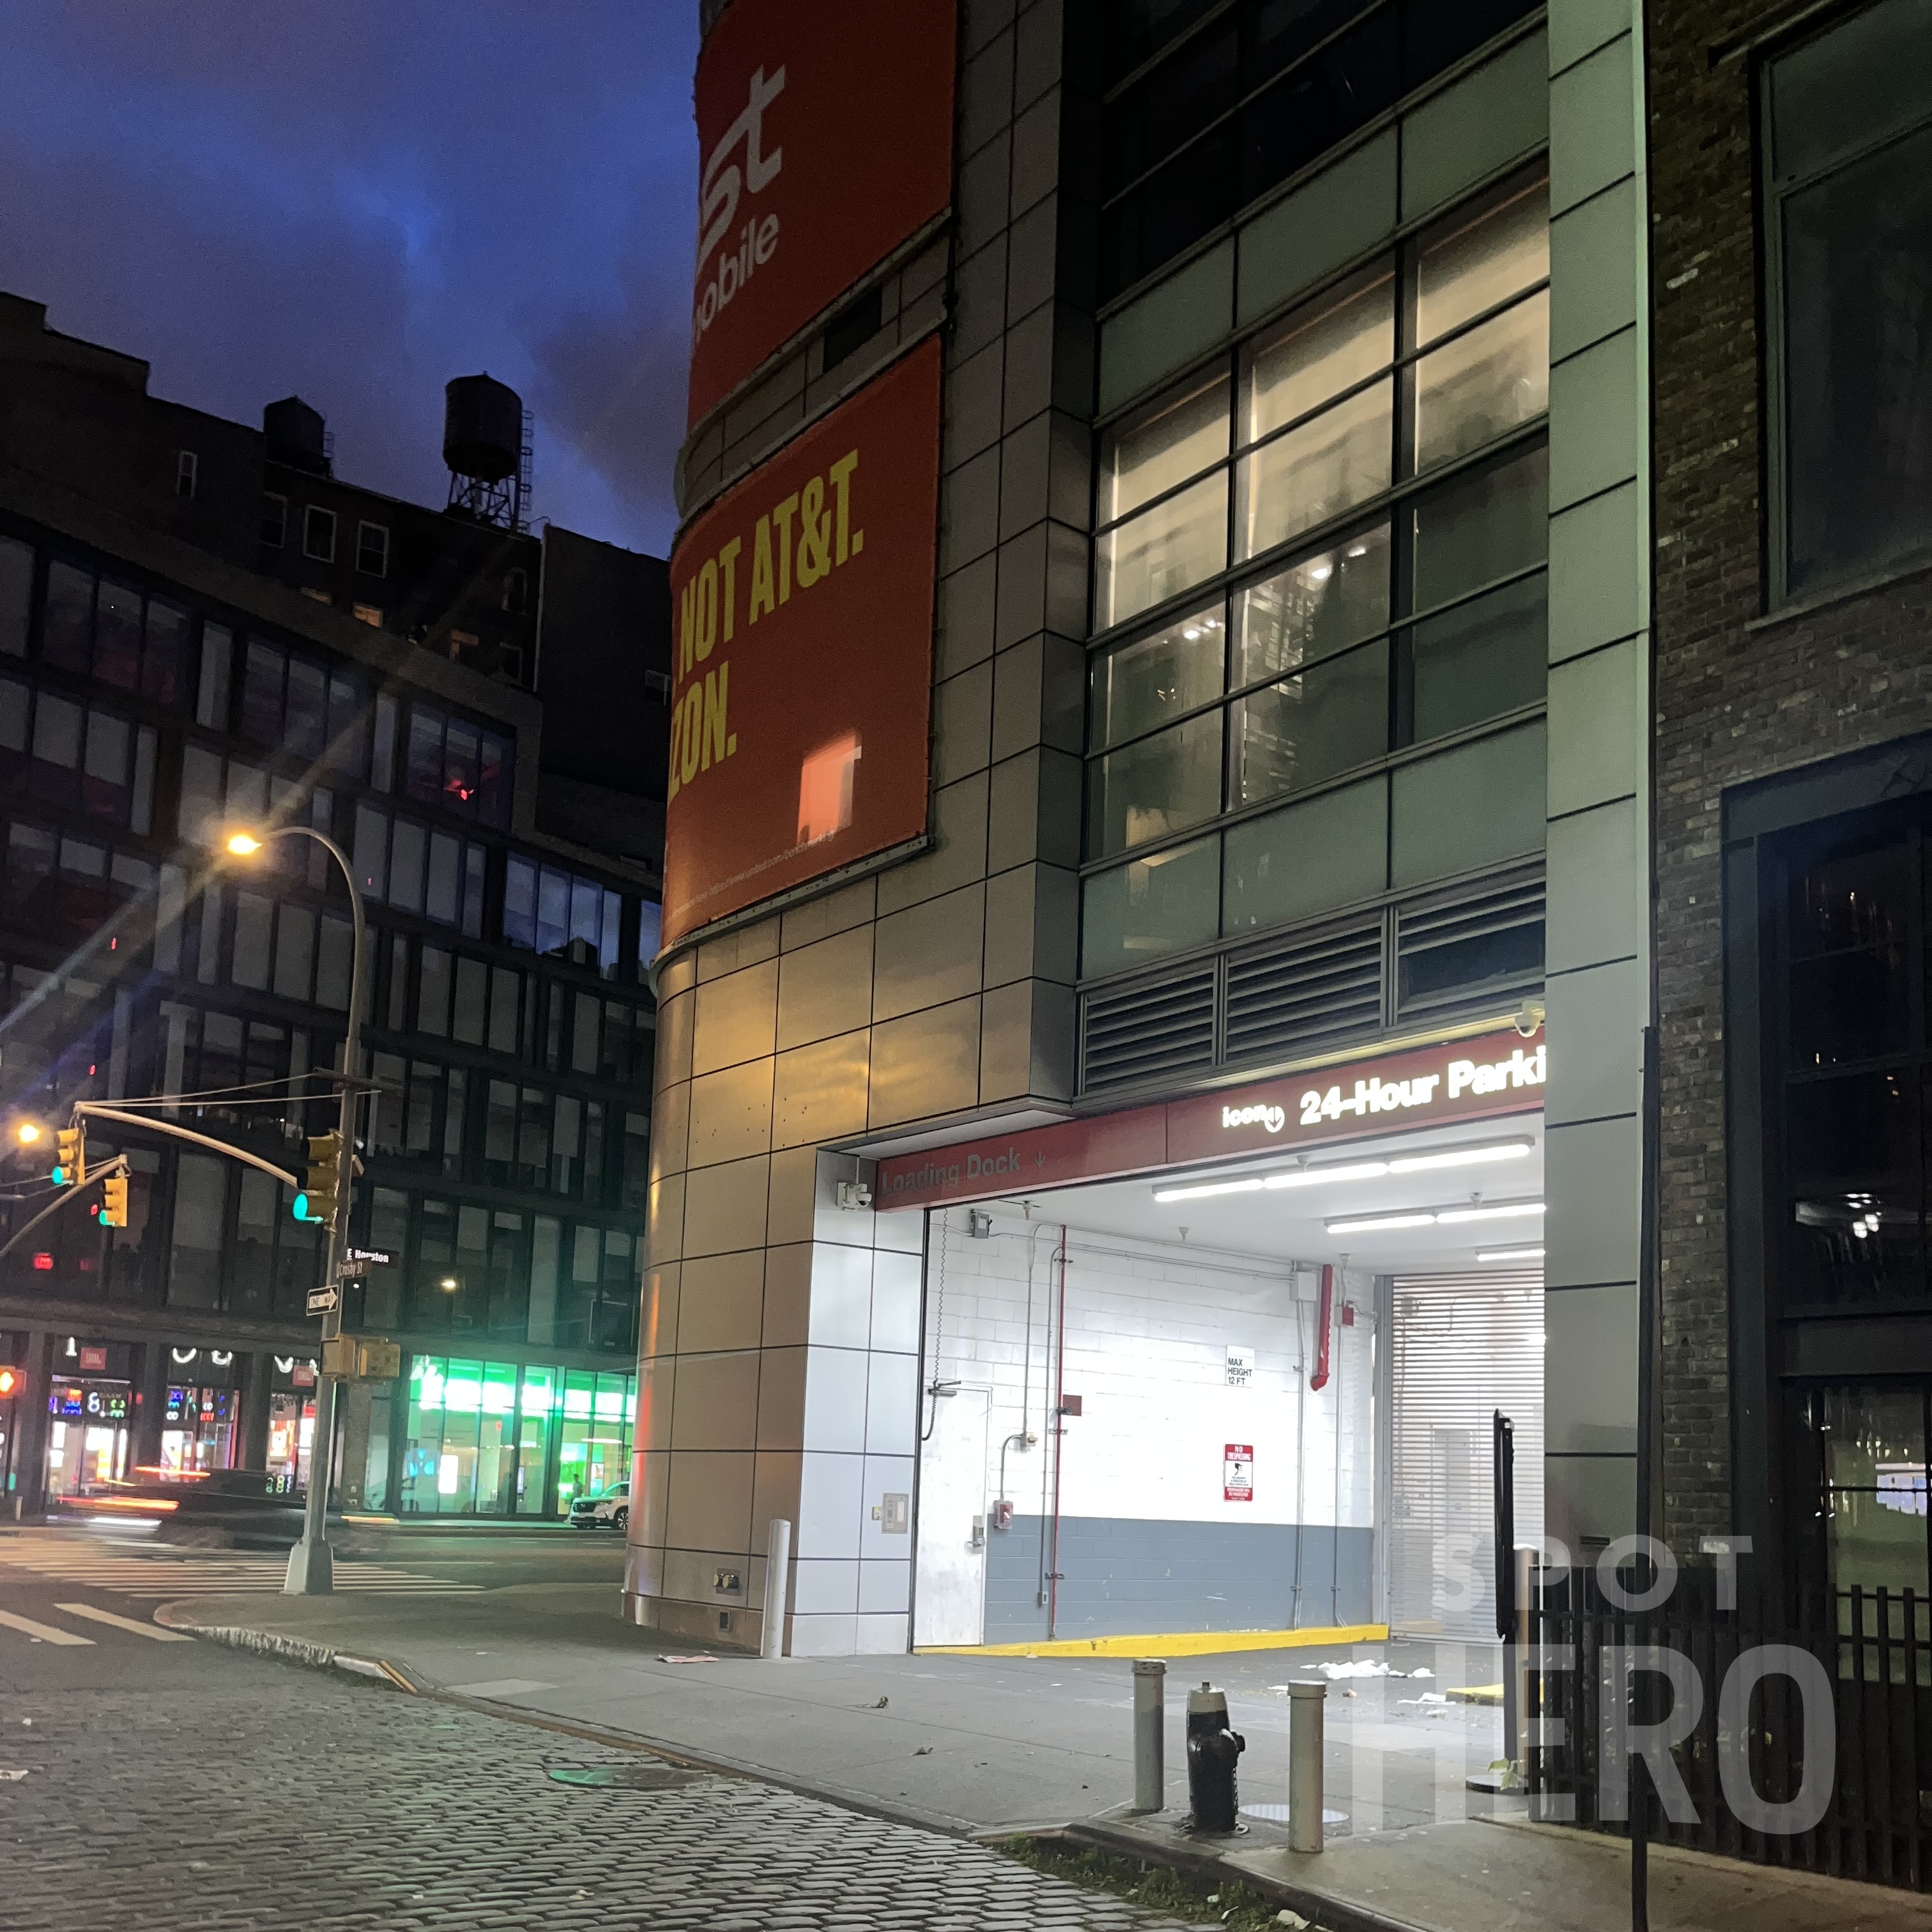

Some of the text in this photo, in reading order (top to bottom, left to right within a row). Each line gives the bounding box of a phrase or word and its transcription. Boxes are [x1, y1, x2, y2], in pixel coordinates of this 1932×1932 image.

[696, 213, 779, 343] obile
[678, 448, 864, 684] NOT AT&T.
[1222, 1103, 1267, 1128] icon
[1300, 1074, 1440, 1125] 24-Hour
[881, 1147, 1021, 1195] Loading Dock
[347, 1248, 389, 1263] E Houston
[310, 1294, 334, 1307] ONE WAY
[1228, 1357, 1243, 1367] MAX
[1227, 1367, 1252, 1377] HEIGHT
[1228, 1376, 1245, 1385] 12 FT
